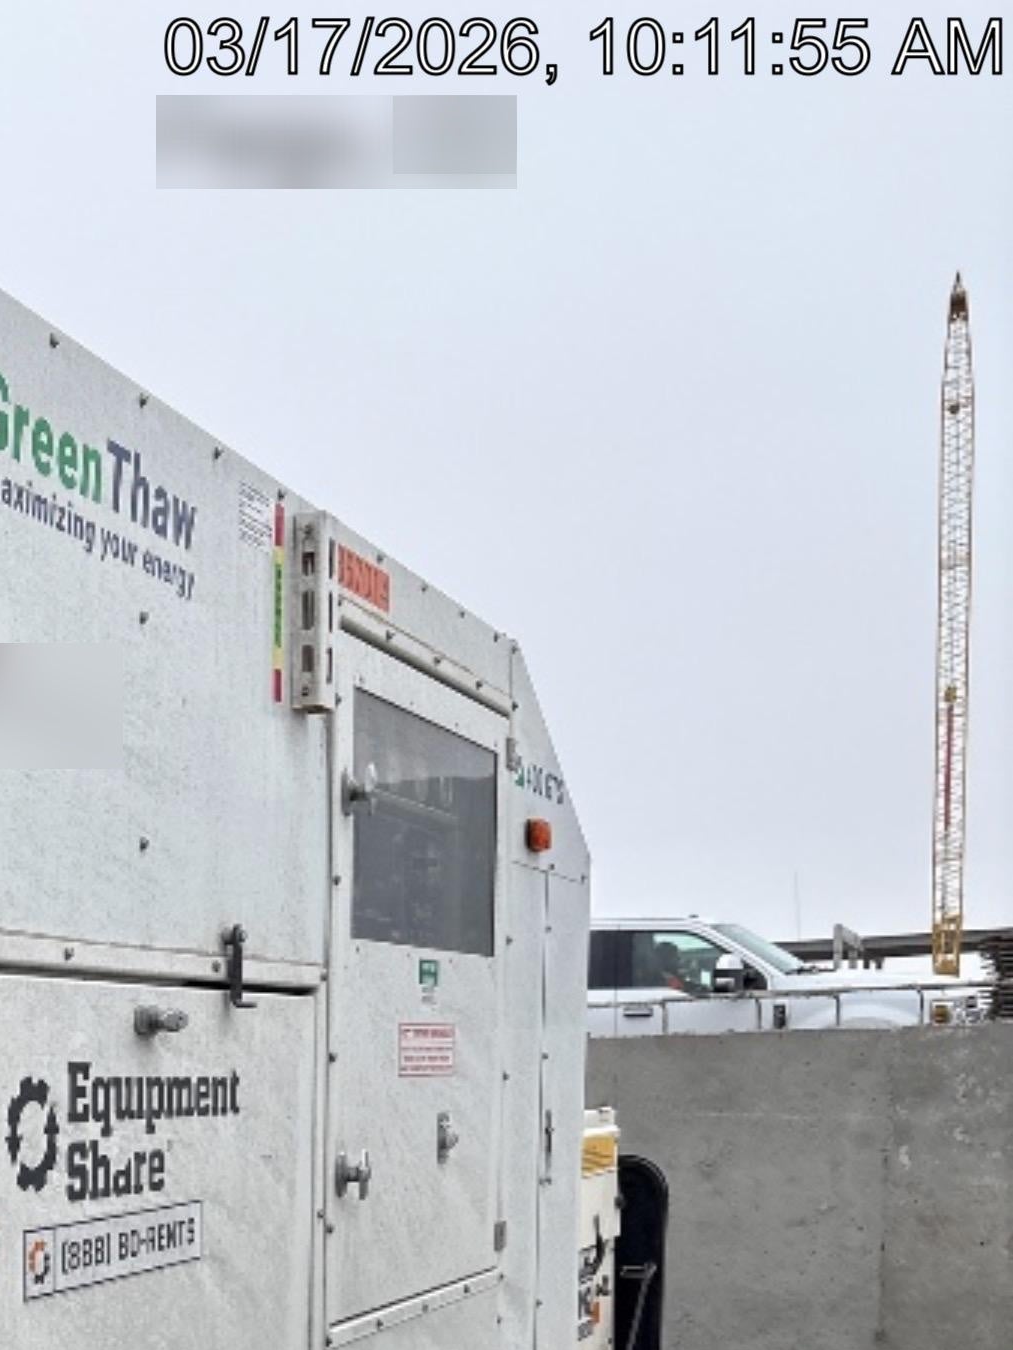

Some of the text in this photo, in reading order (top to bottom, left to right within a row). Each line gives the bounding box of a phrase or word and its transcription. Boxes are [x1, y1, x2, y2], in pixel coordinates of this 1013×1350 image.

[99, 527, 139, 562] your
[142, 549, 196, 601] energy
[67, 1061, 240, 1138] Equipment
[67, 1139, 166, 1202] Share
[61, 1232, 112, 1275] (888)
